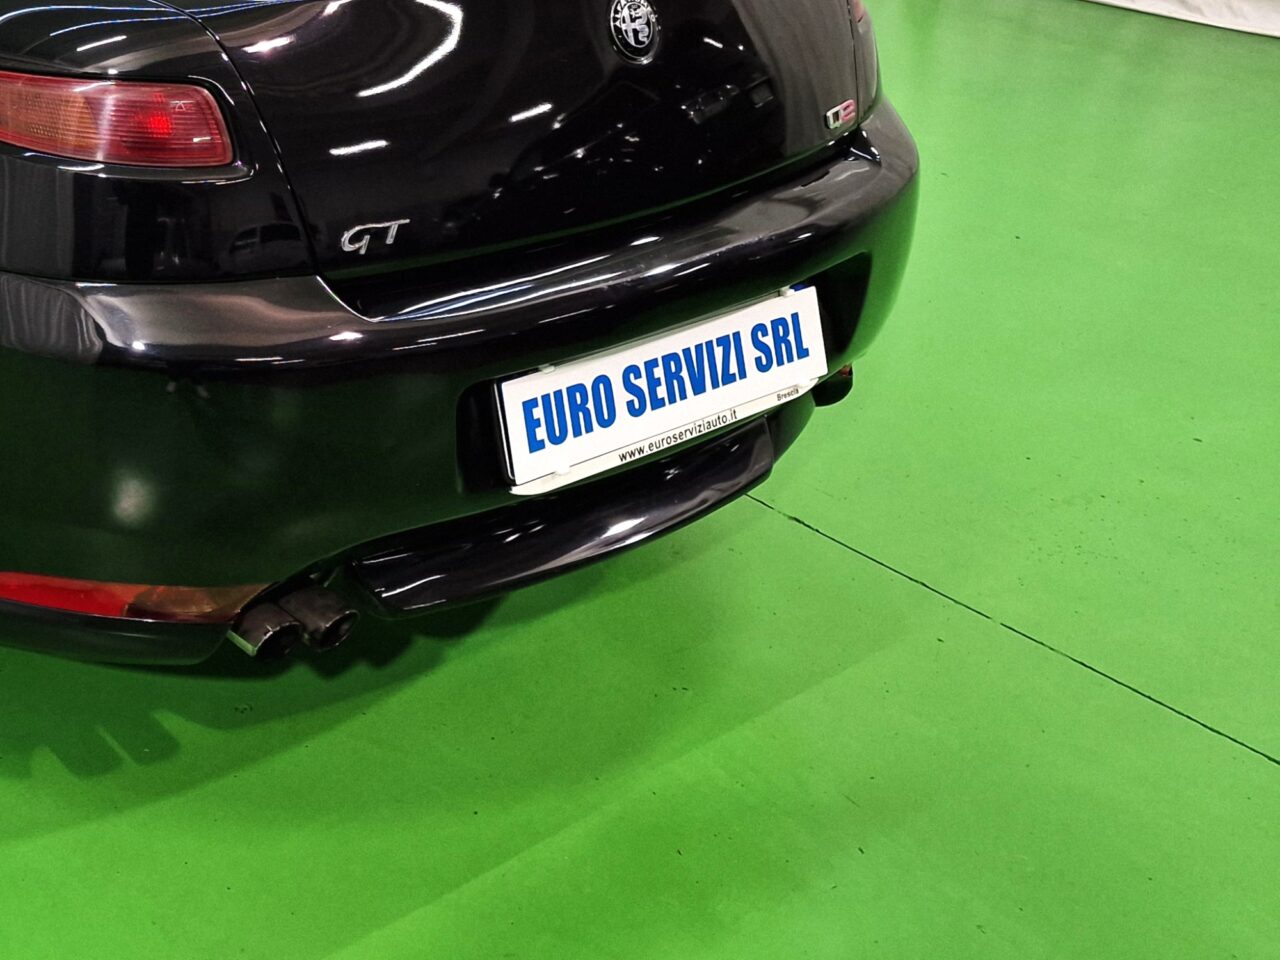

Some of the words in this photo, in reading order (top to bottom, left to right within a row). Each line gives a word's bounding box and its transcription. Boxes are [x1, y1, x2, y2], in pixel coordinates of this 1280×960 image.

[341, 219, 410, 254] GT
[522, 374, 616, 453] EURO
[622, 330, 747, 417] SERVIZI
[750, 312, 809, 372] SRL
[618, 409, 738, 462] www.euroserviziauto.it
